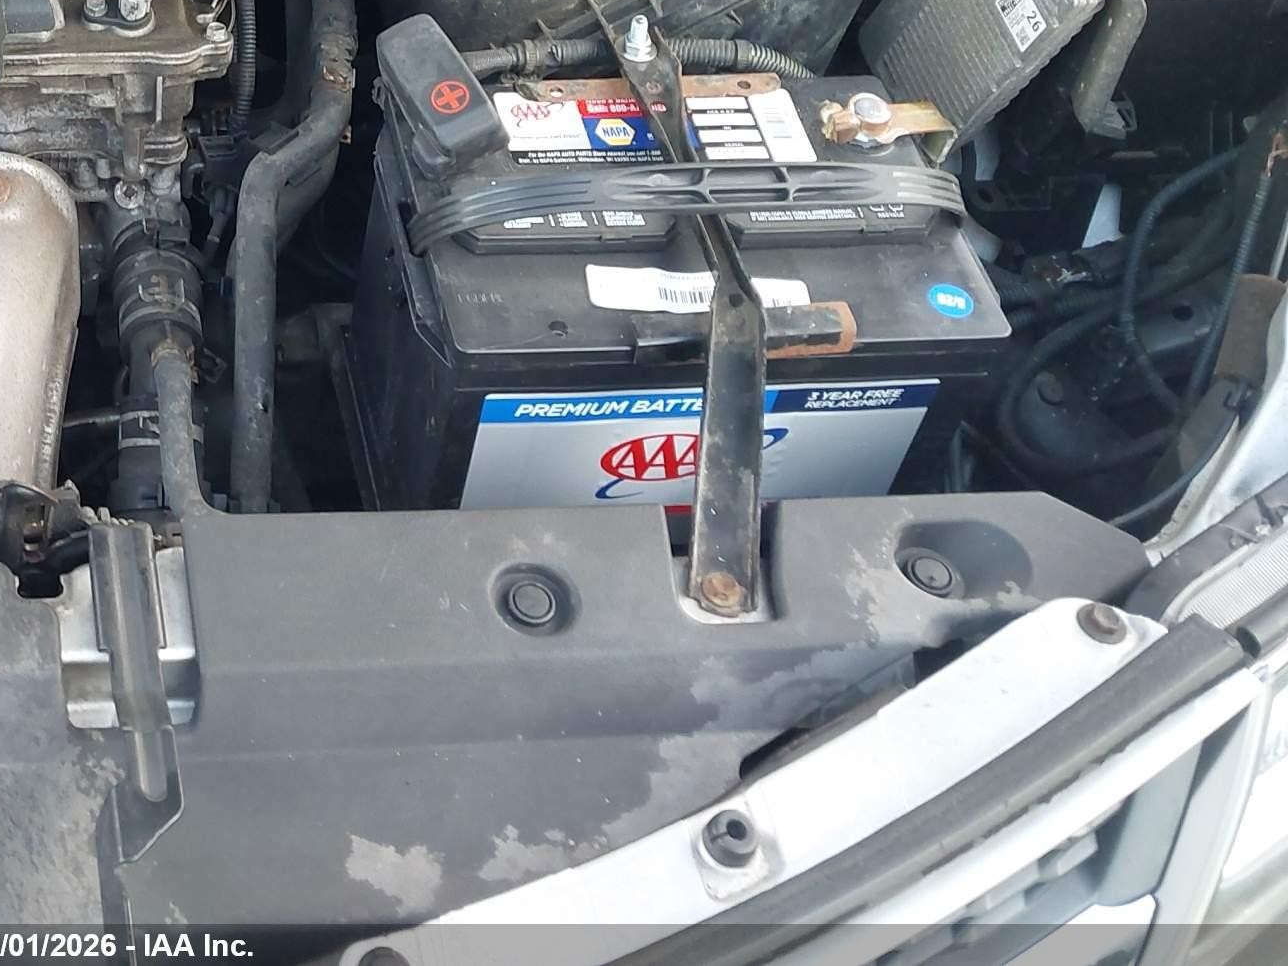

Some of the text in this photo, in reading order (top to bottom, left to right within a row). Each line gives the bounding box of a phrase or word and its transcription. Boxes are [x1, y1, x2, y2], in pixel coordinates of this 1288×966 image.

[1026, 10, 1043, 32] 26
[511, 105, 551, 121] AAA
[602, 126, 631, 138] NAPA
[807, 388, 905, 401] 3 YEAR FREE
[514, 397, 704, 418] PREMIUM BATTE
[804, 397, 898, 409] REPLACEMENT
